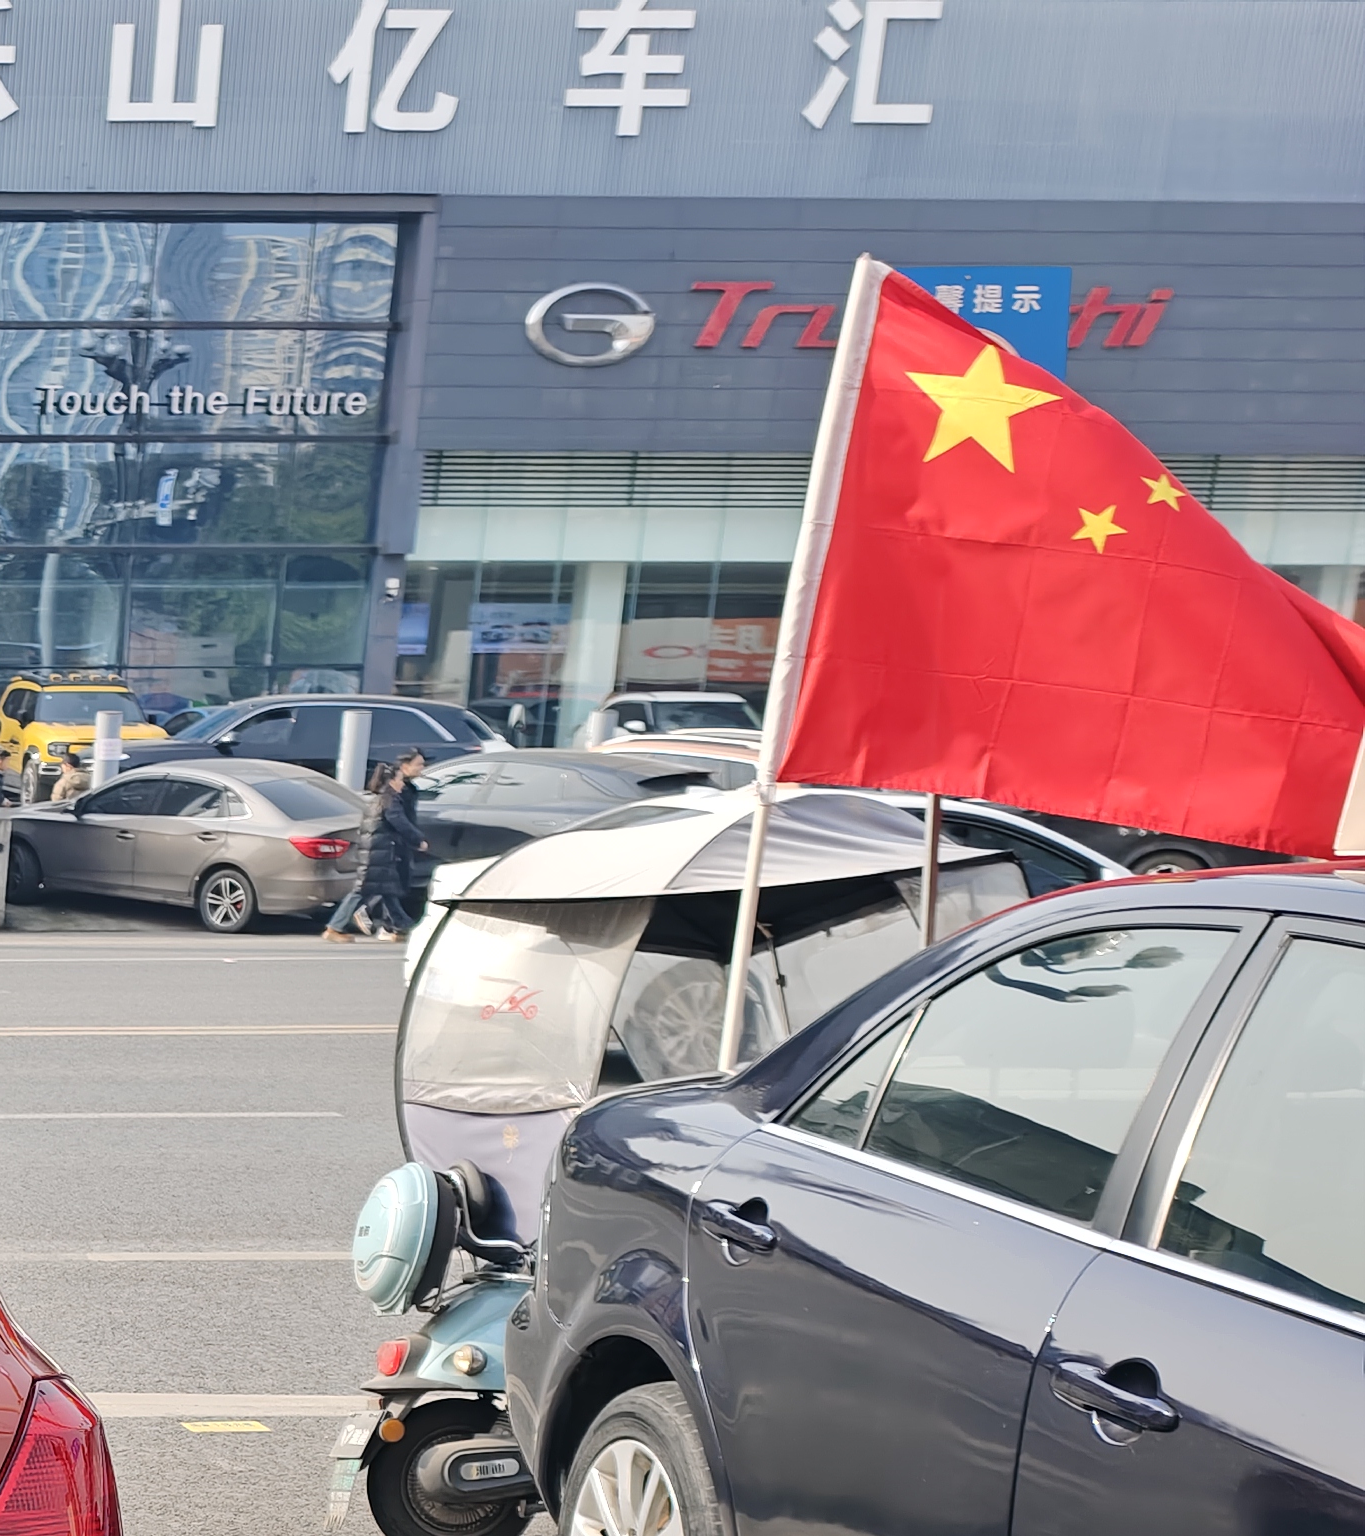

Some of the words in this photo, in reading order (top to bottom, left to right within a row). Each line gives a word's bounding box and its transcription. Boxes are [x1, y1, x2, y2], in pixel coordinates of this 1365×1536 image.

[36, 384, 150, 415] Touch
[171, 385, 229, 415] the
[243, 385, 368, 416] Future
